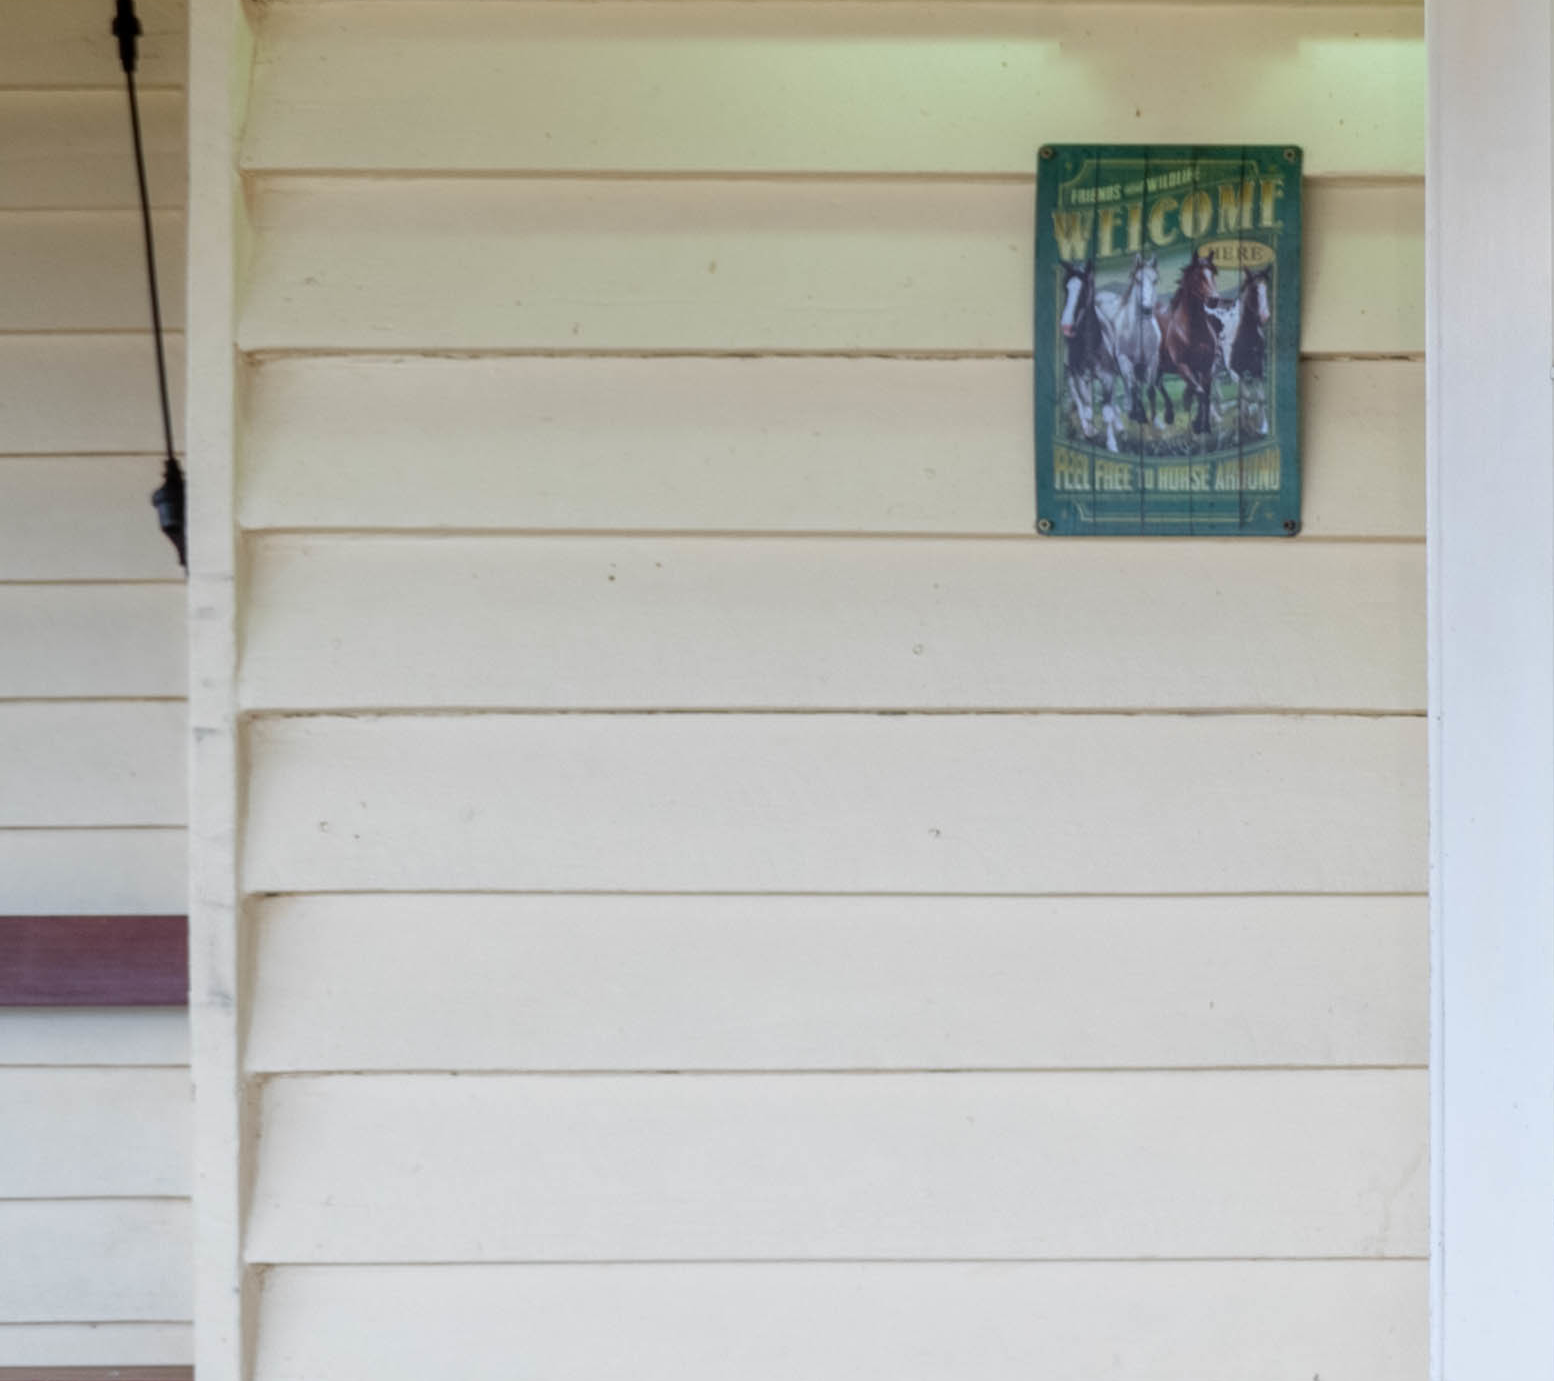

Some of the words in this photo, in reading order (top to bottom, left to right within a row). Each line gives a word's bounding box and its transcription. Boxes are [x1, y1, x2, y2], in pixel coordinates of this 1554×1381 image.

[1071, 184, 1121, 204] FRIENDS
[1052, 178, 1284, 261] WELCOME
[1208, 246, 1265, 261] HERE
[1053, 446, 1091, 491] FEEL
[1095, 457, 1134, 491] FREE
[1157, 464, 1211, 491] HORSE
[1214, 446, 1282, 491] AROUND
